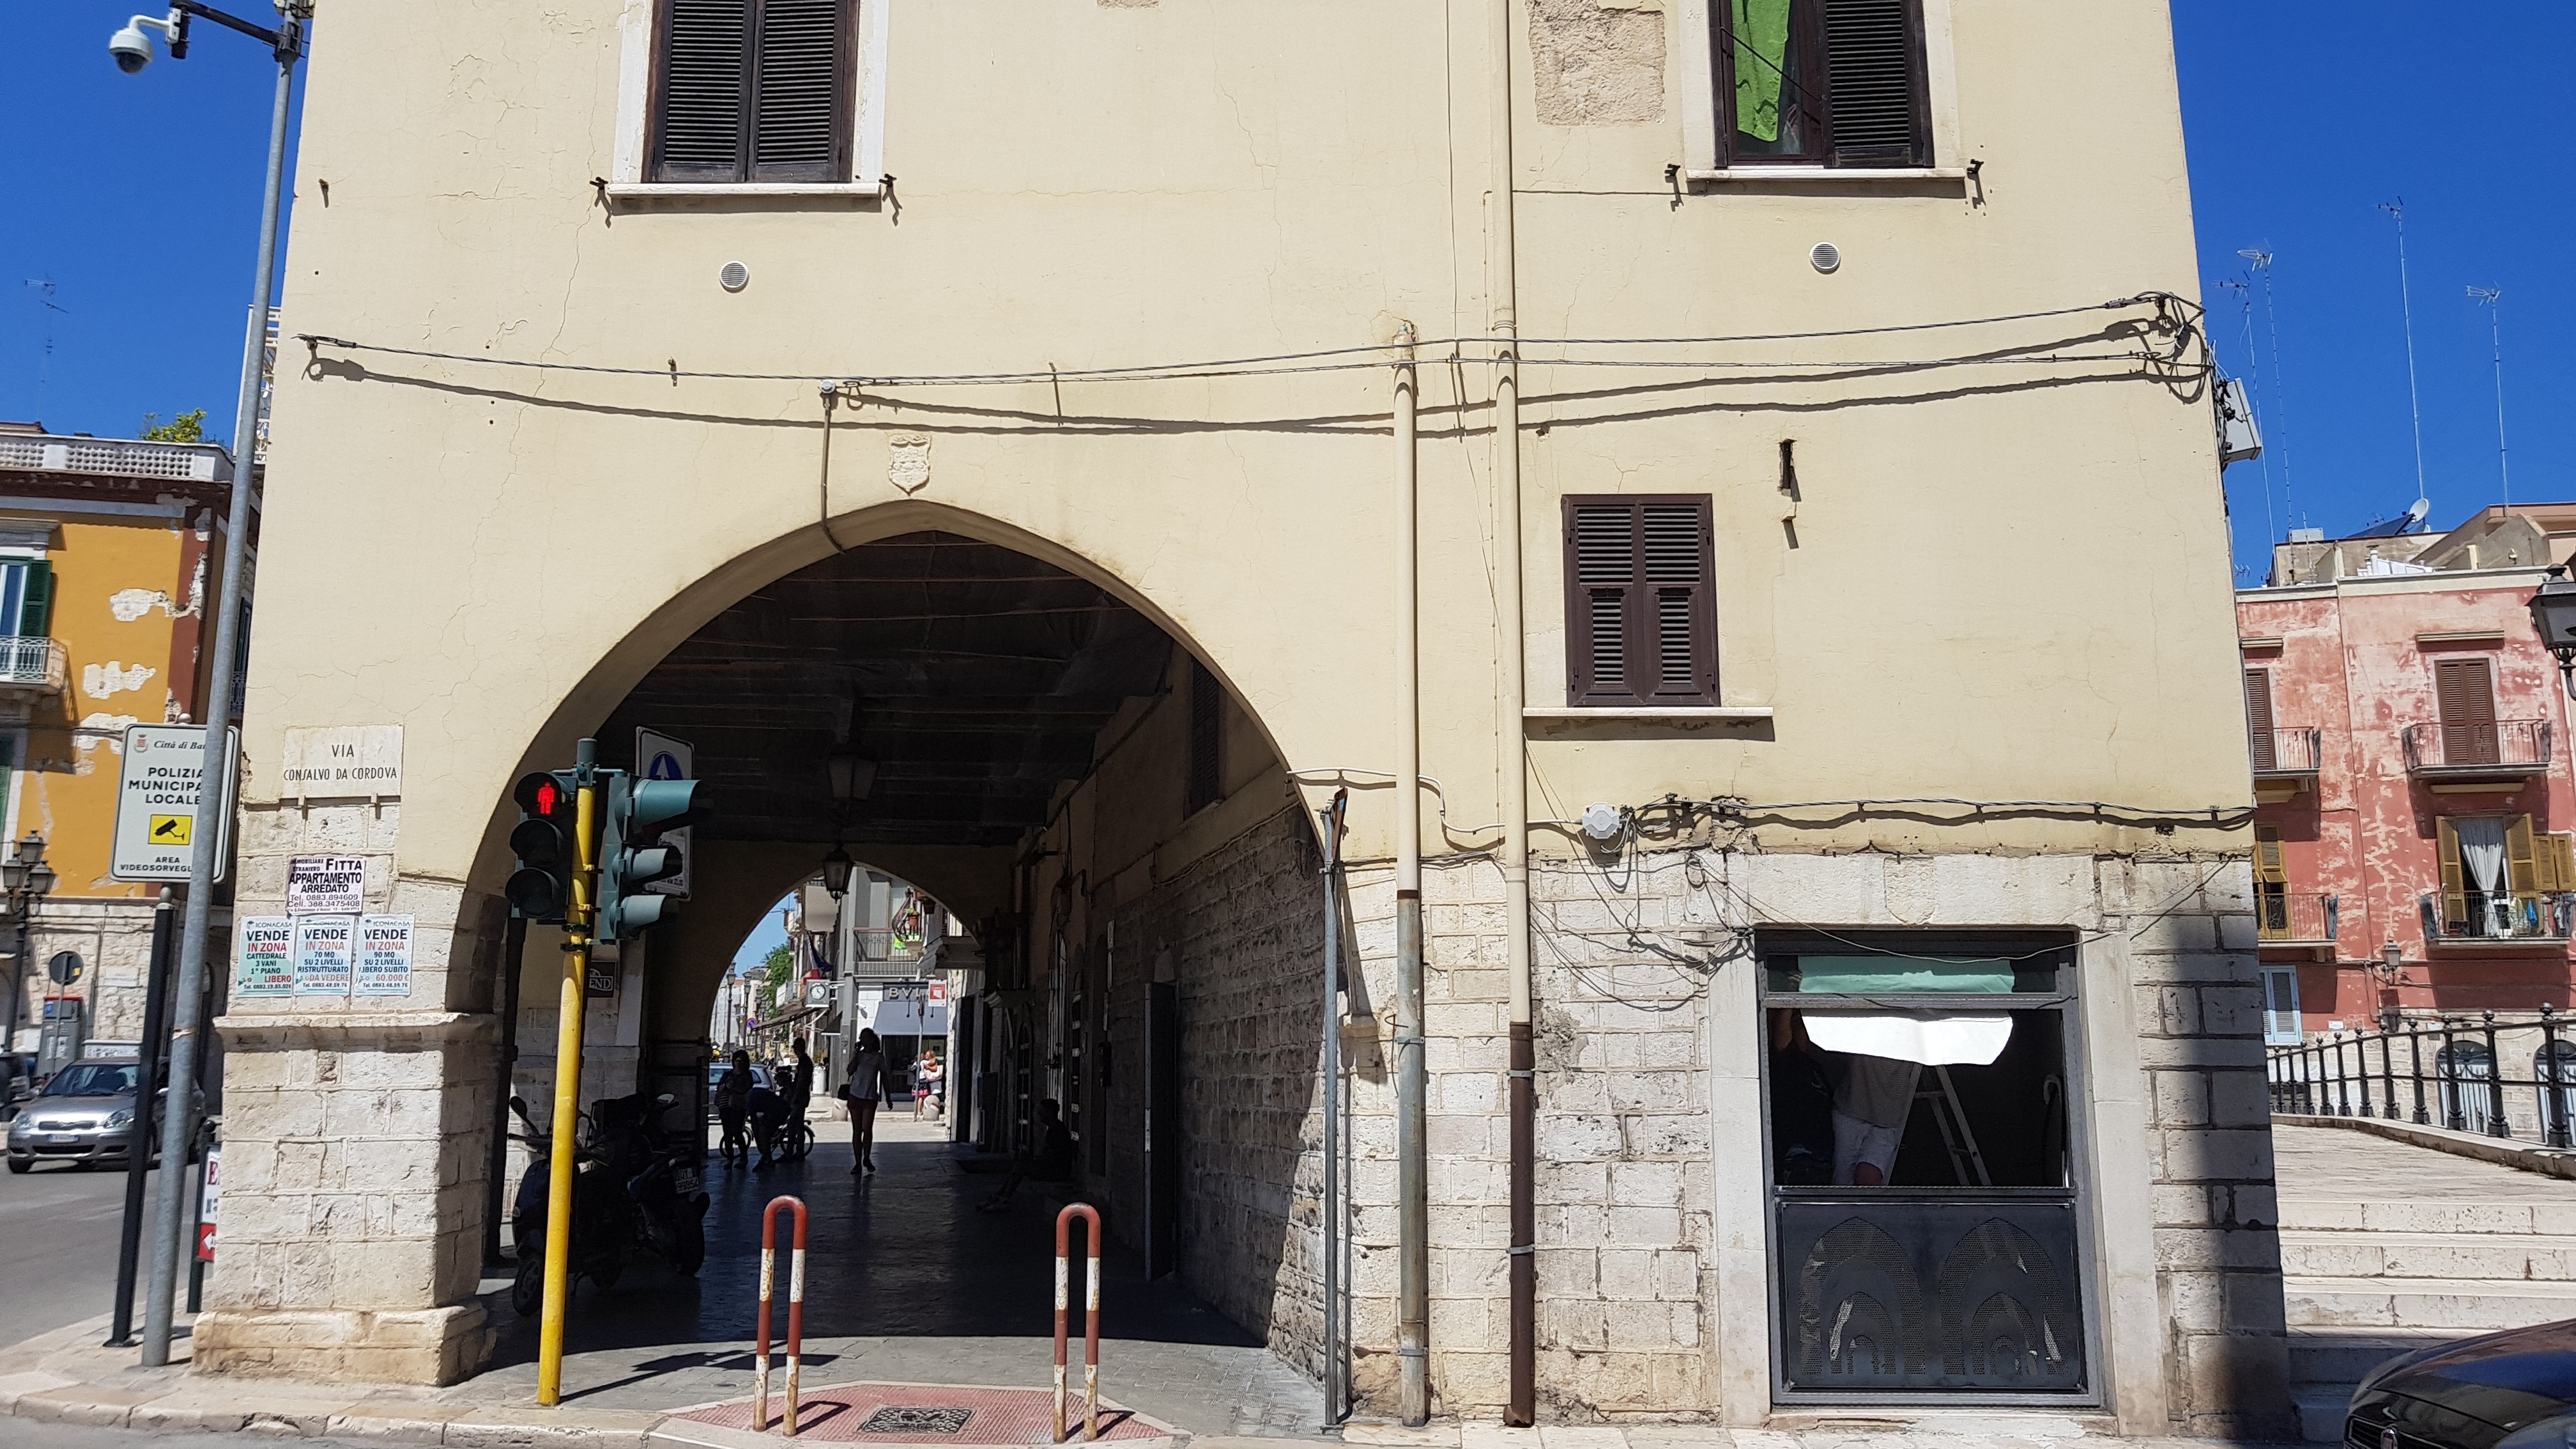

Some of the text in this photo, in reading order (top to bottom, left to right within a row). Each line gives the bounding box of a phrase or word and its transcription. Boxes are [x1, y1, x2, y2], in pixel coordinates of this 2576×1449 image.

[153, 740, 206, 750] Città di Bar
[331, 744, 355, 758] VIA
[148, 767, 204, 779] POLIZIA
[283, 767, 397, 781] CONSALVO DA CORDOVA
[128, 779, 202, 792] MUNICIPA
[145, 793, 201, 805] LOCALE
[119, 864, 192, 873] VIDEOSORVEGL
[325, 858, 363, 871] FITTA
[288, 871, 362, 885] APPARTAMENTO
[300, 884, 349, 893] ARREDATO
[247, 930, 290, 941] VENDE
[304, 929, 348, 940] VENDE
[364, 929, 408, 940] VENDE
[247, 942, 287, 952] IN ZONA
[305, 941, 345, 951] IN ZONA
[365, 941, 405, 951] IN ZONA
[589, 978, 611, 989] END
[889, 987, 928, 998] BVL
